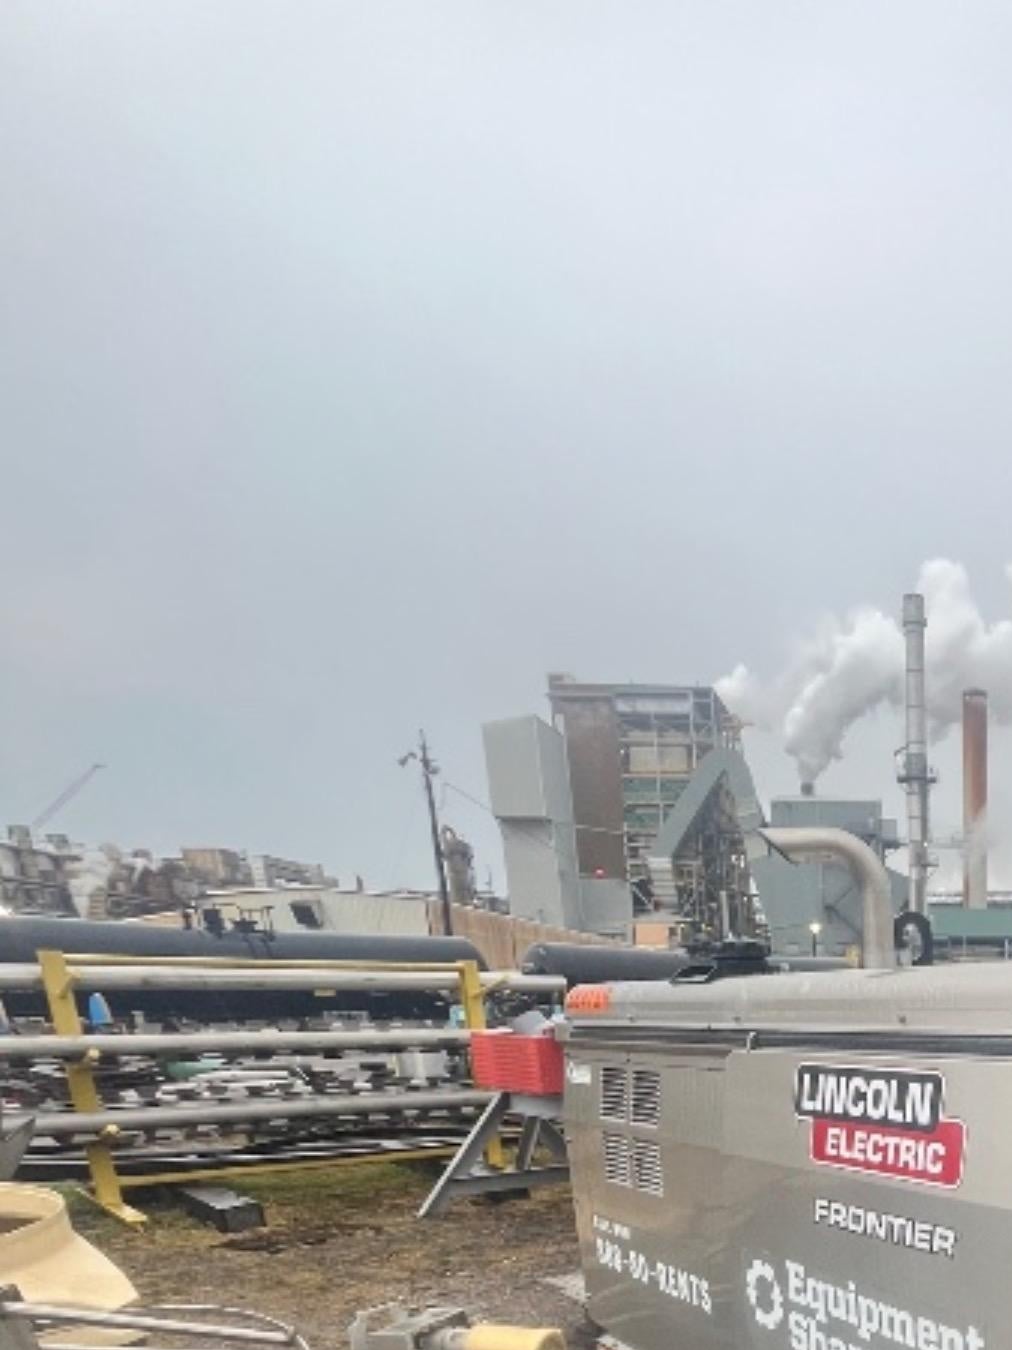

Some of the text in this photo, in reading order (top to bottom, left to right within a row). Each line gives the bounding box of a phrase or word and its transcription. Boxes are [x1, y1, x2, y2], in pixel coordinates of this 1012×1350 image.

[801, 1073, 934, 1126] LINCOLN
[825, 1127, 946, 1174] ELECTRIC
[815, 1199, 956, 1256] FRONTIER
